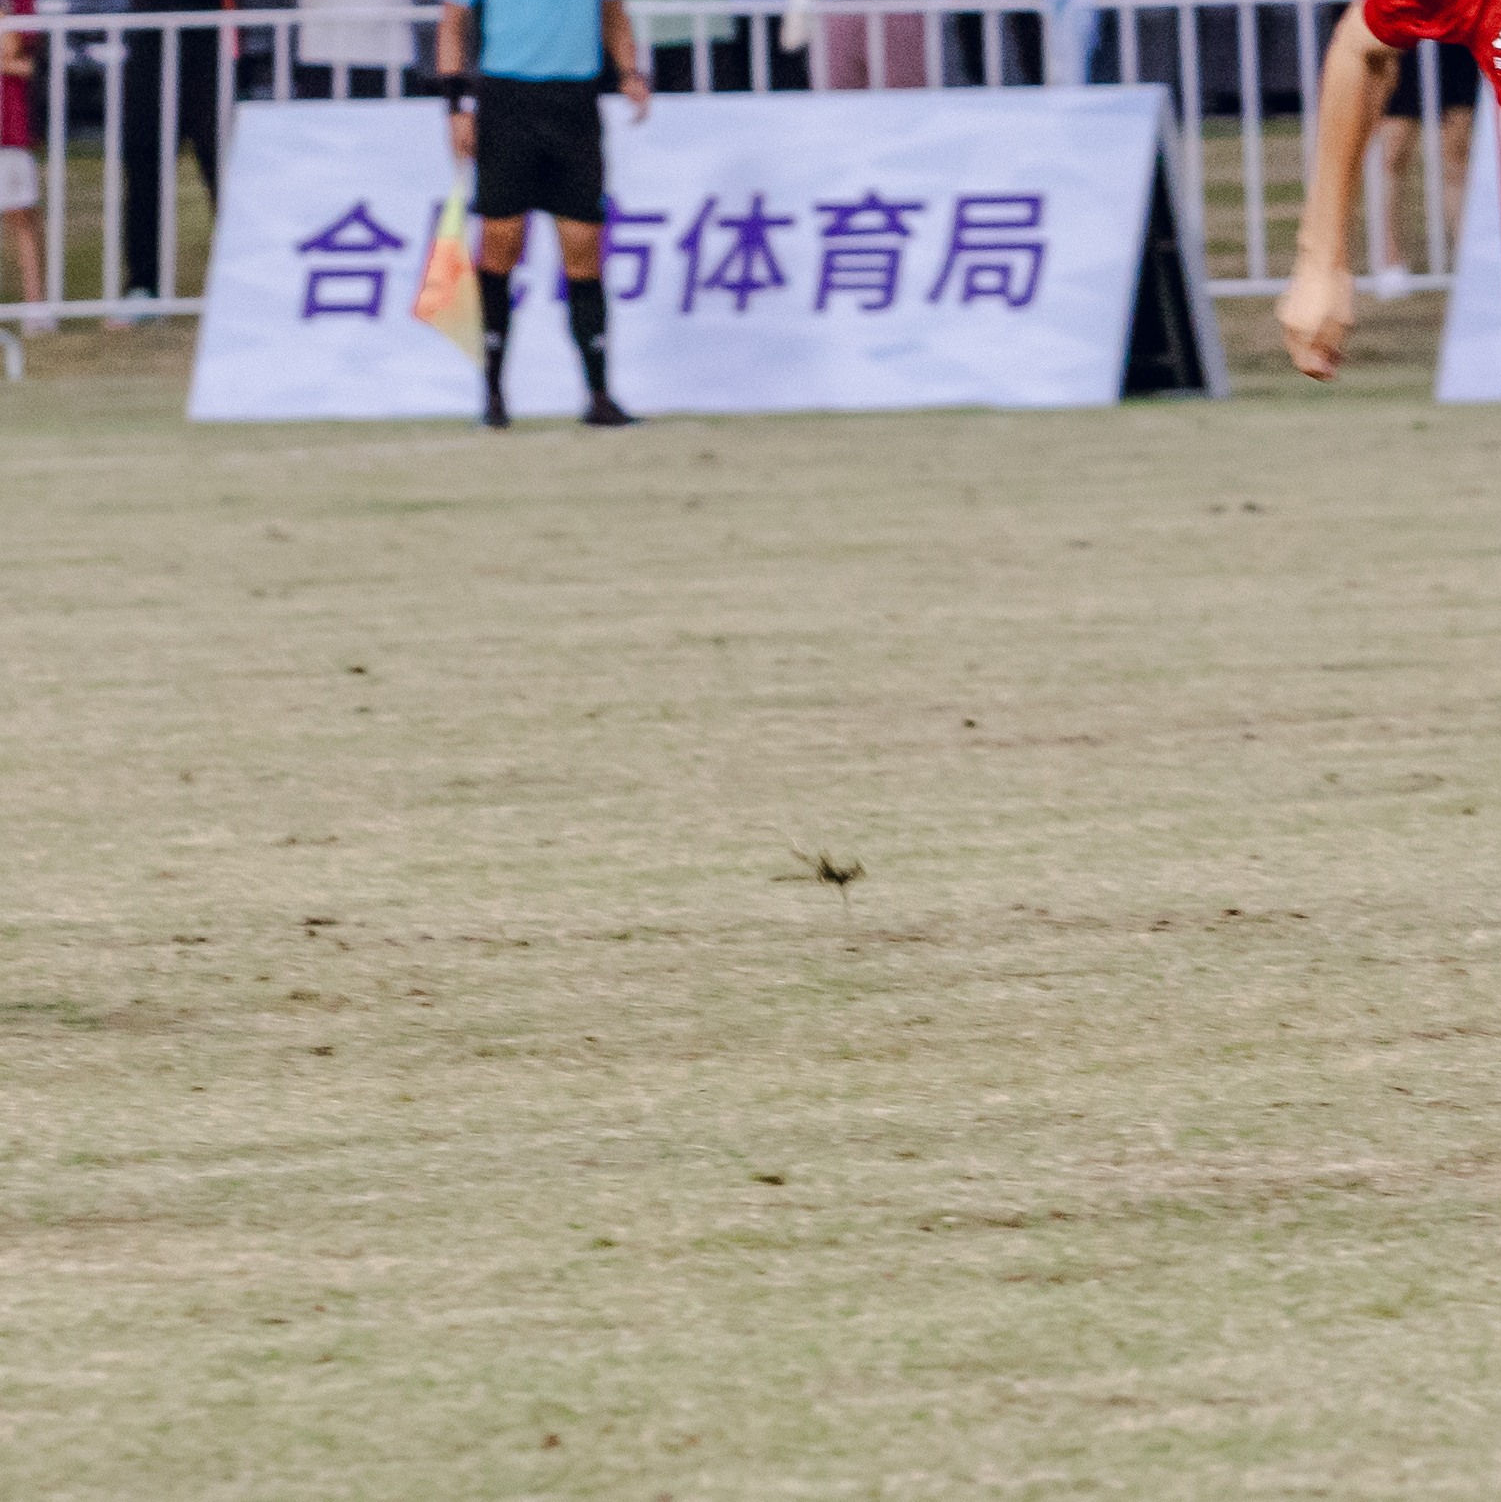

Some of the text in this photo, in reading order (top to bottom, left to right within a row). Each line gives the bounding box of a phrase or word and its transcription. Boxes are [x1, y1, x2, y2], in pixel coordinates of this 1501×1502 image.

[296, 188, 1045, 321] 合市体育局
